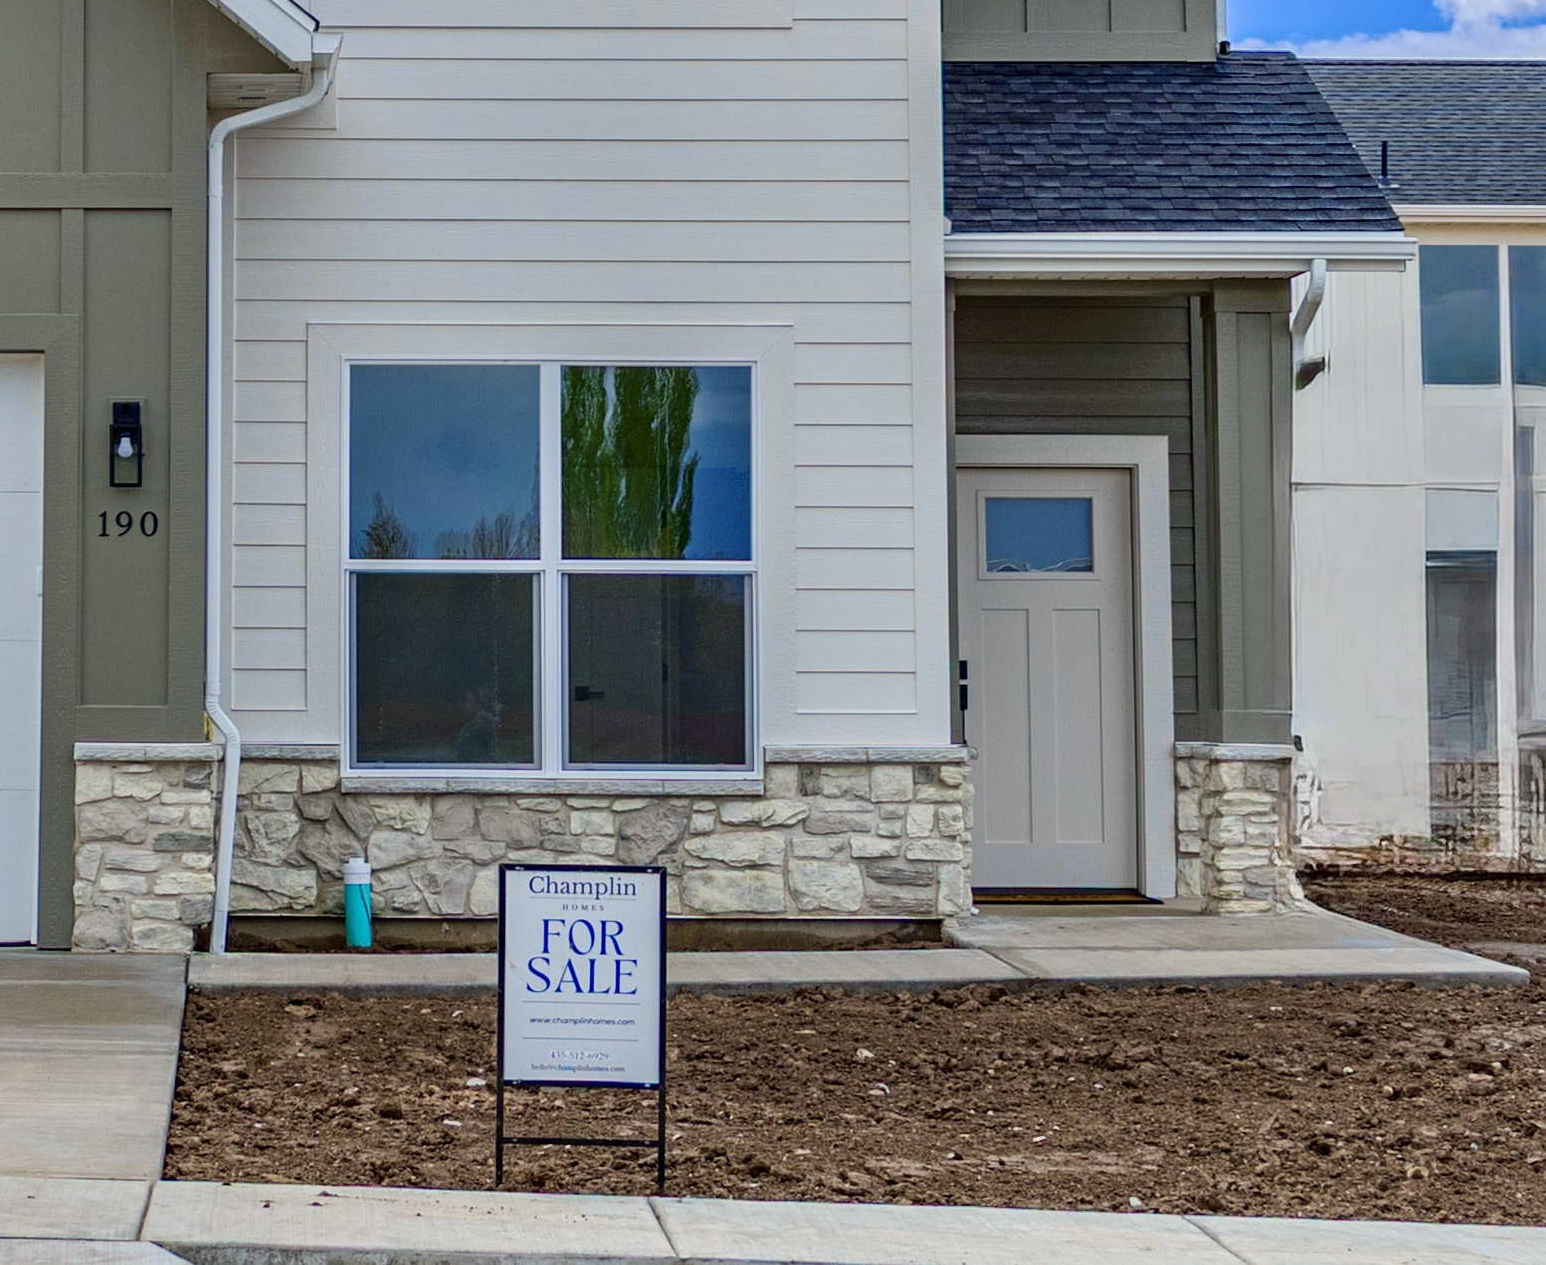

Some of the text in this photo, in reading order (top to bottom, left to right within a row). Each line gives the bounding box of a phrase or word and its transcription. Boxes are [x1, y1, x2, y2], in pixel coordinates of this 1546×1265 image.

[97, 510, 159, 537] 190
[528, 875, 637, 900] Champlin
[562, 903, 605, 912] HOMES
[541, 918, 624, 956] FOR
[526, 956, 638, 995] SALE
[529, 1016, 635, 1026] www.champlinhomes.com
